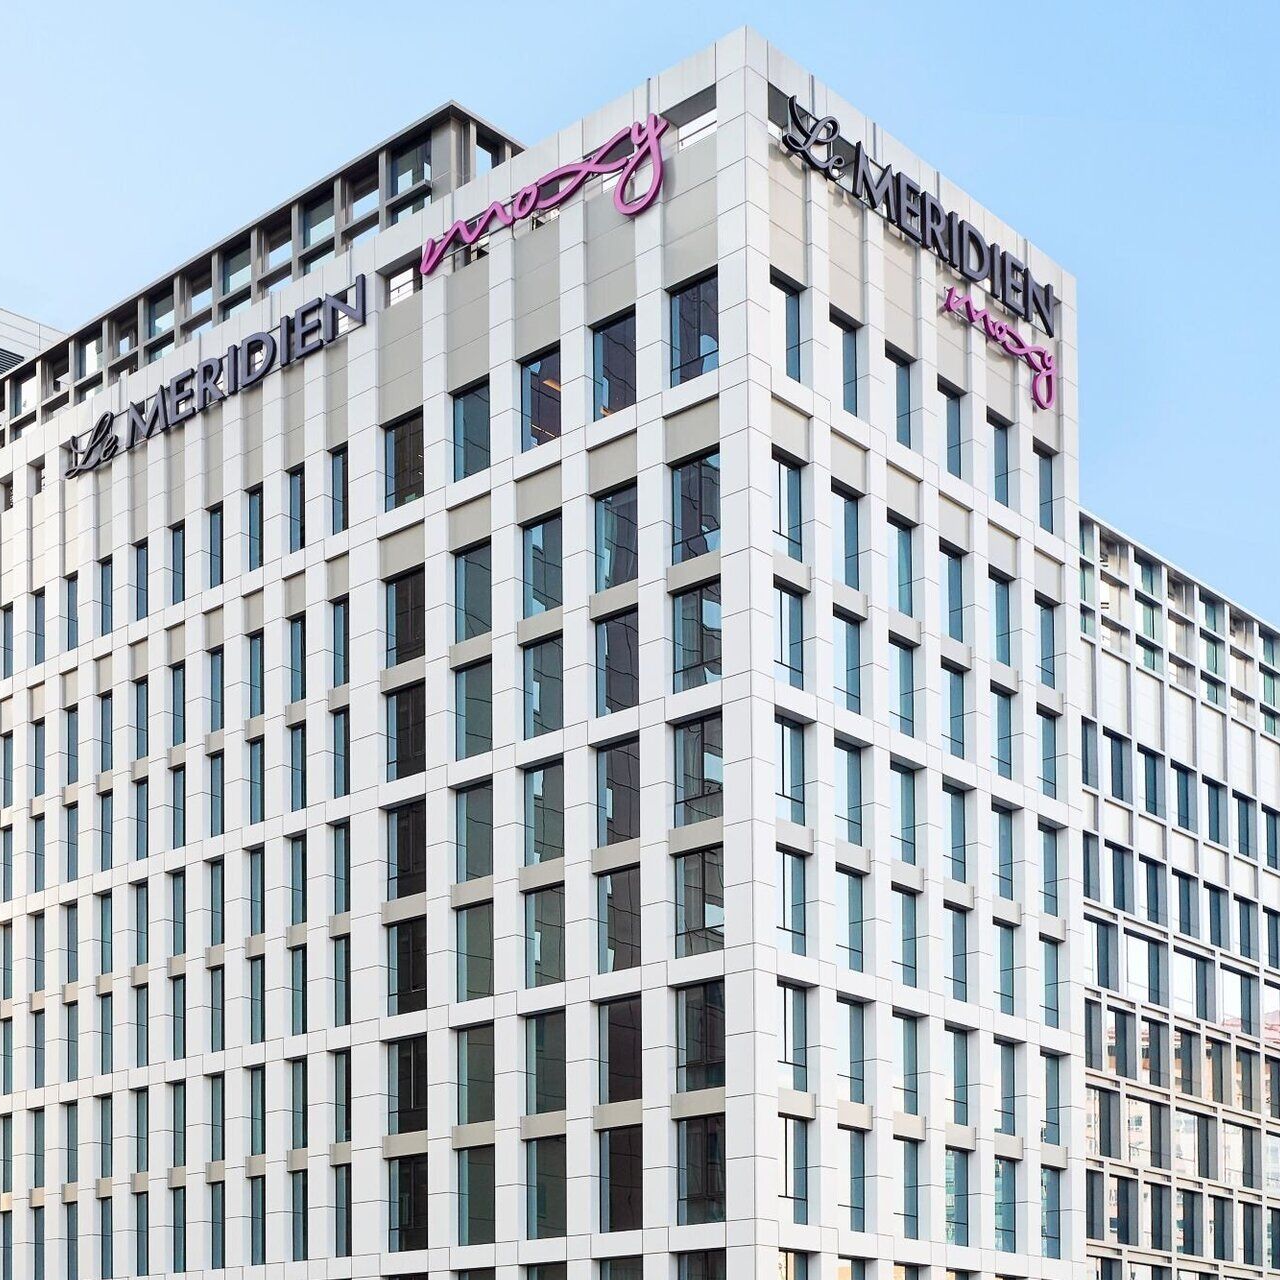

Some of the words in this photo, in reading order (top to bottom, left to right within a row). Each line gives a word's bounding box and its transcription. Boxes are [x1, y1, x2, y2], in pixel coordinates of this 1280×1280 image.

[420, 112, 670, 275] moxy
[782, 95, 845, 181] Le
[852, 141, 1055, 338] MERIDIEN
[64, 411, 118, 480] Le
[126, 273, 366, 449] MERIDIEN
[944, 286, 1056, 410] moxy
